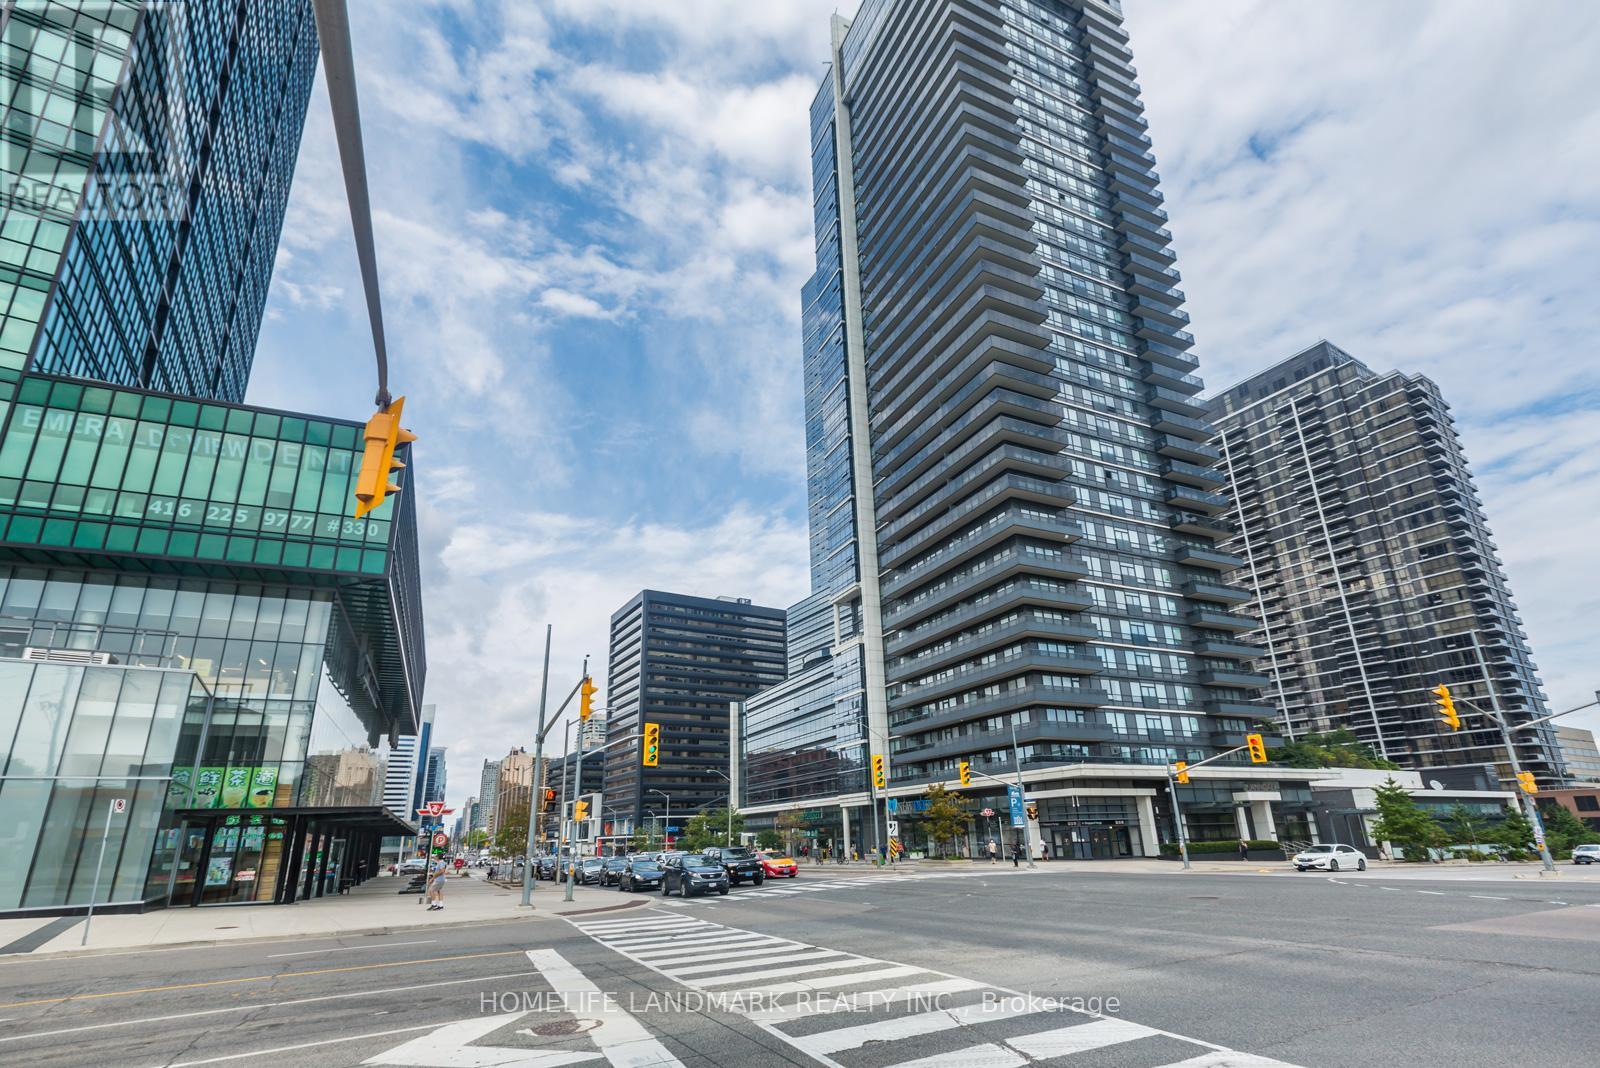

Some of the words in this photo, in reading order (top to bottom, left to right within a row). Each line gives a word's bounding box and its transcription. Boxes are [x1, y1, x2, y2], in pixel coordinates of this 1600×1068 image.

[148, 500, 192, 517] 416
[206, 506, 249, 523] 225
[263, 512, 315, 530] 9777
[327, 519, 379, 537] #330
